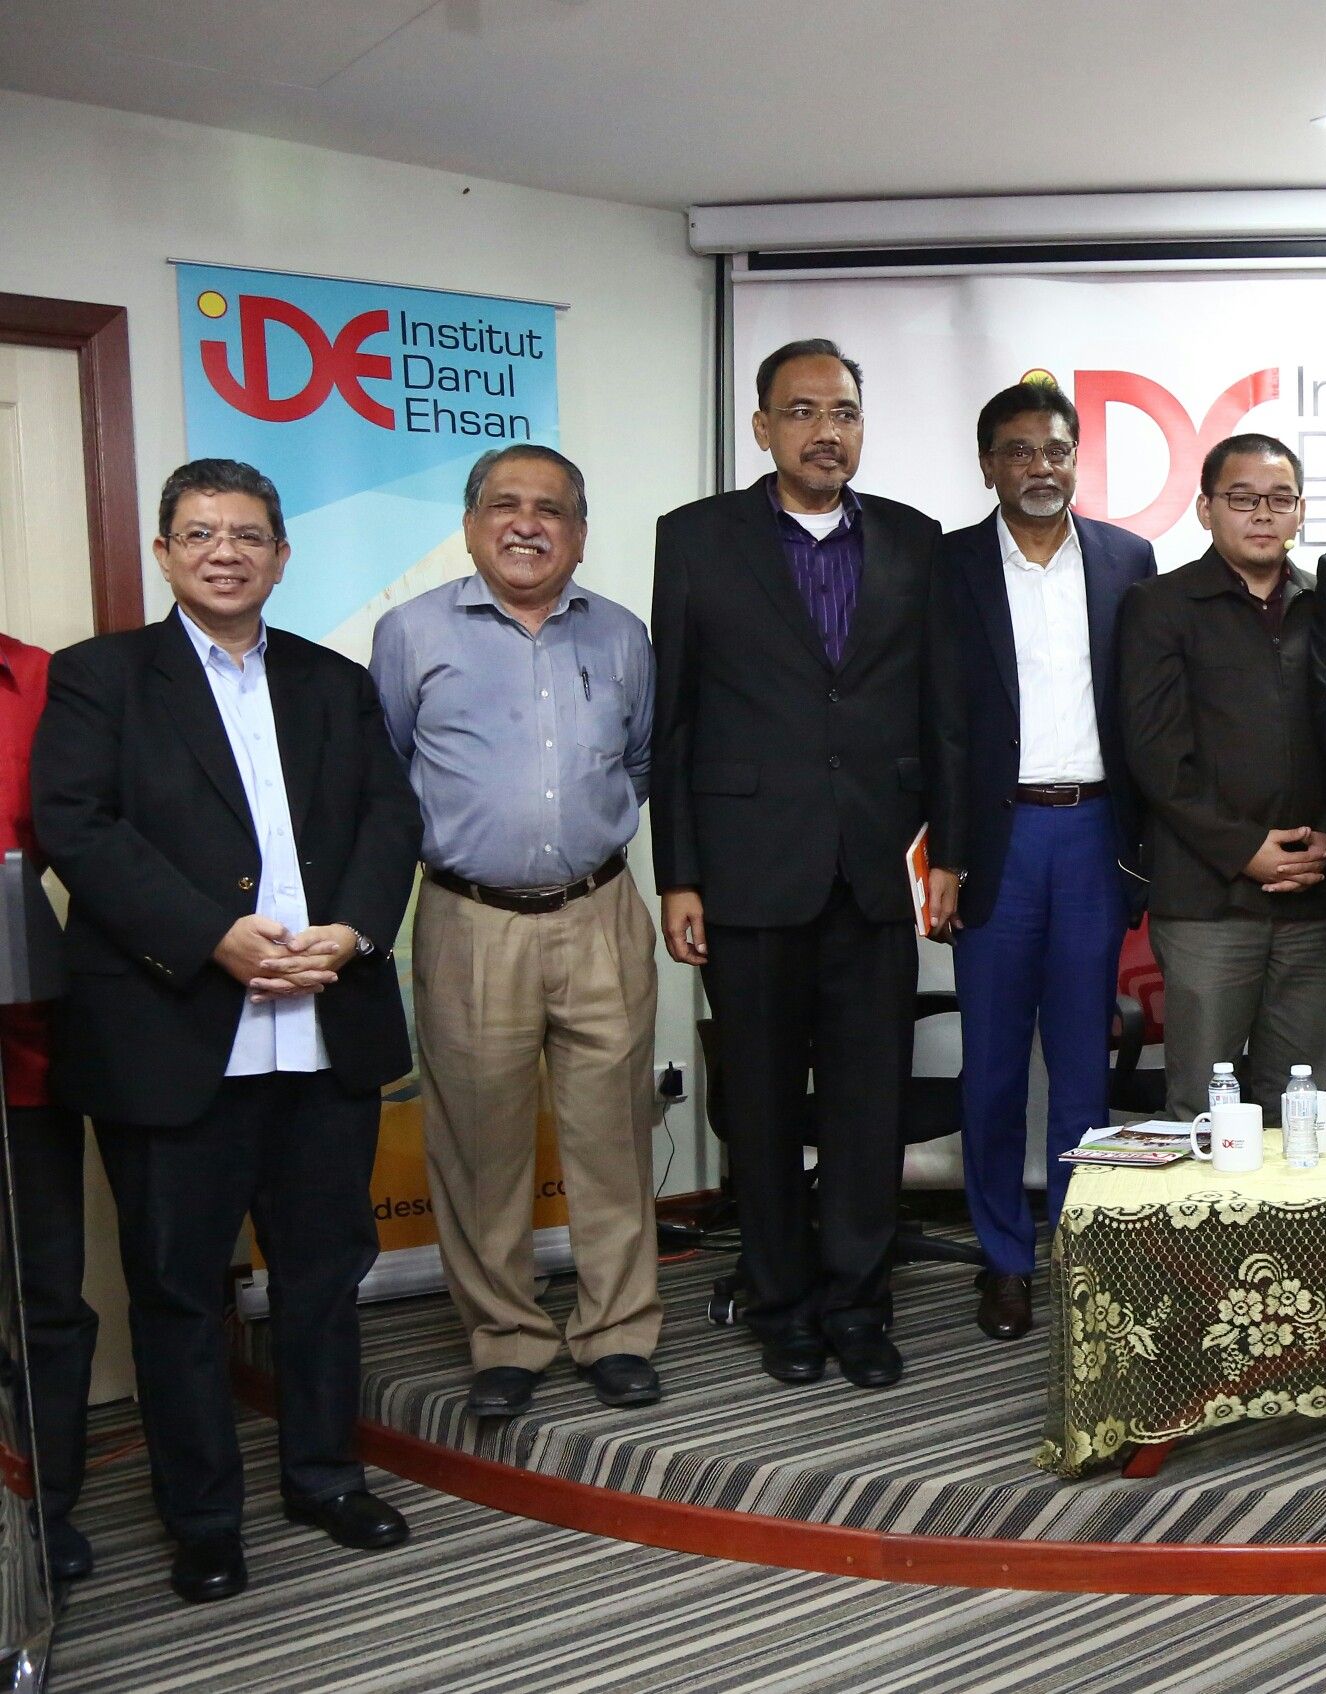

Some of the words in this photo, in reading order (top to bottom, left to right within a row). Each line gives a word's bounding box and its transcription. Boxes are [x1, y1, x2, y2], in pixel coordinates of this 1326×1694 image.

[401, 310, 544, 360] Institut
[403, 354, 515, 397] Darul
[405, 397, 531, 440] Ehsan
